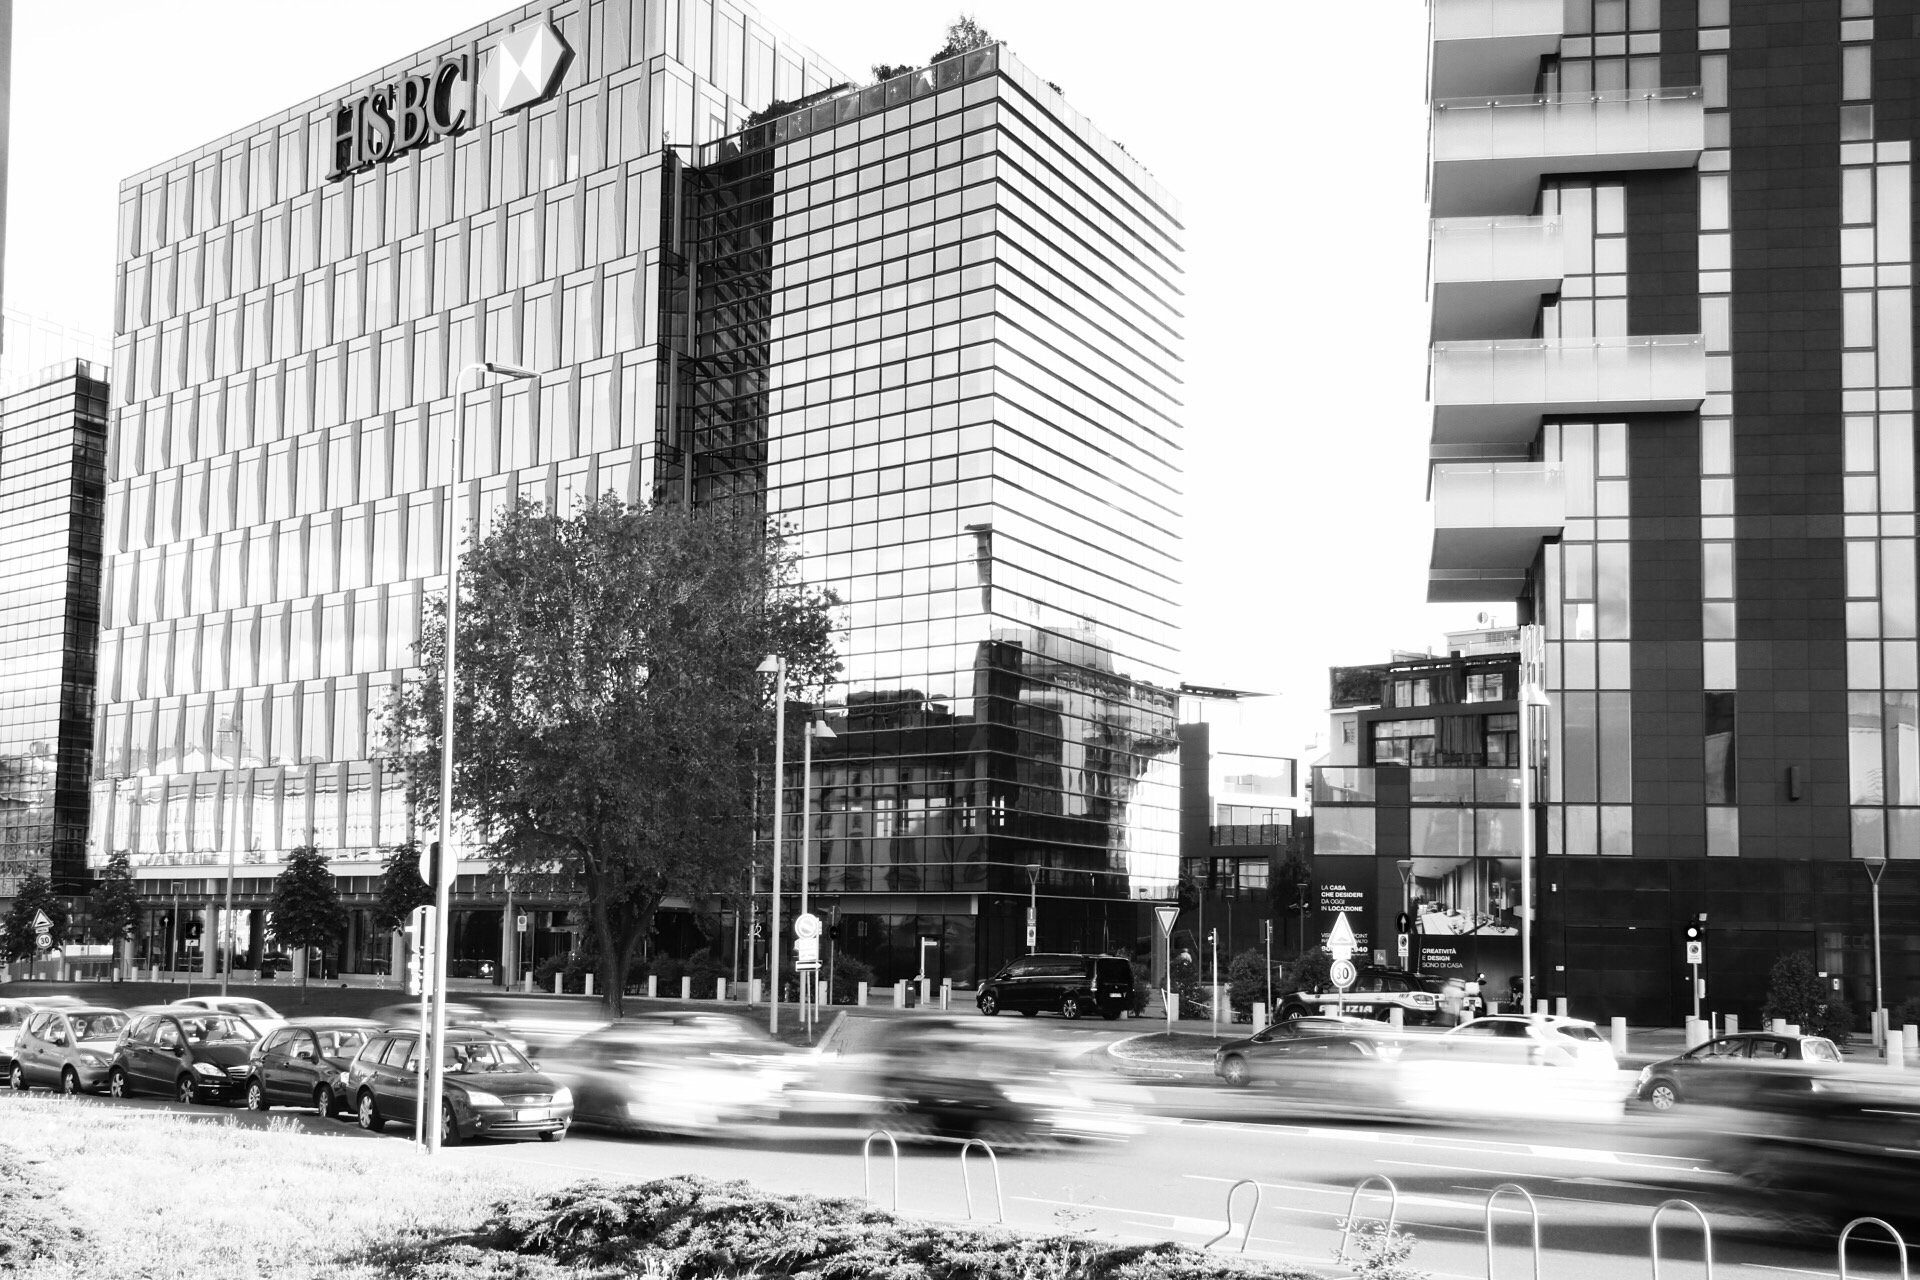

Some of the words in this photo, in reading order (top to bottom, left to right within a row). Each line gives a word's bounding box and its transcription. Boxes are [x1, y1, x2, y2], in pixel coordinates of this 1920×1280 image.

[325, 54, 468, 182] HSBC
[40, 936, 50, 945] 30
[1336, 967, 1349, 980] 30
